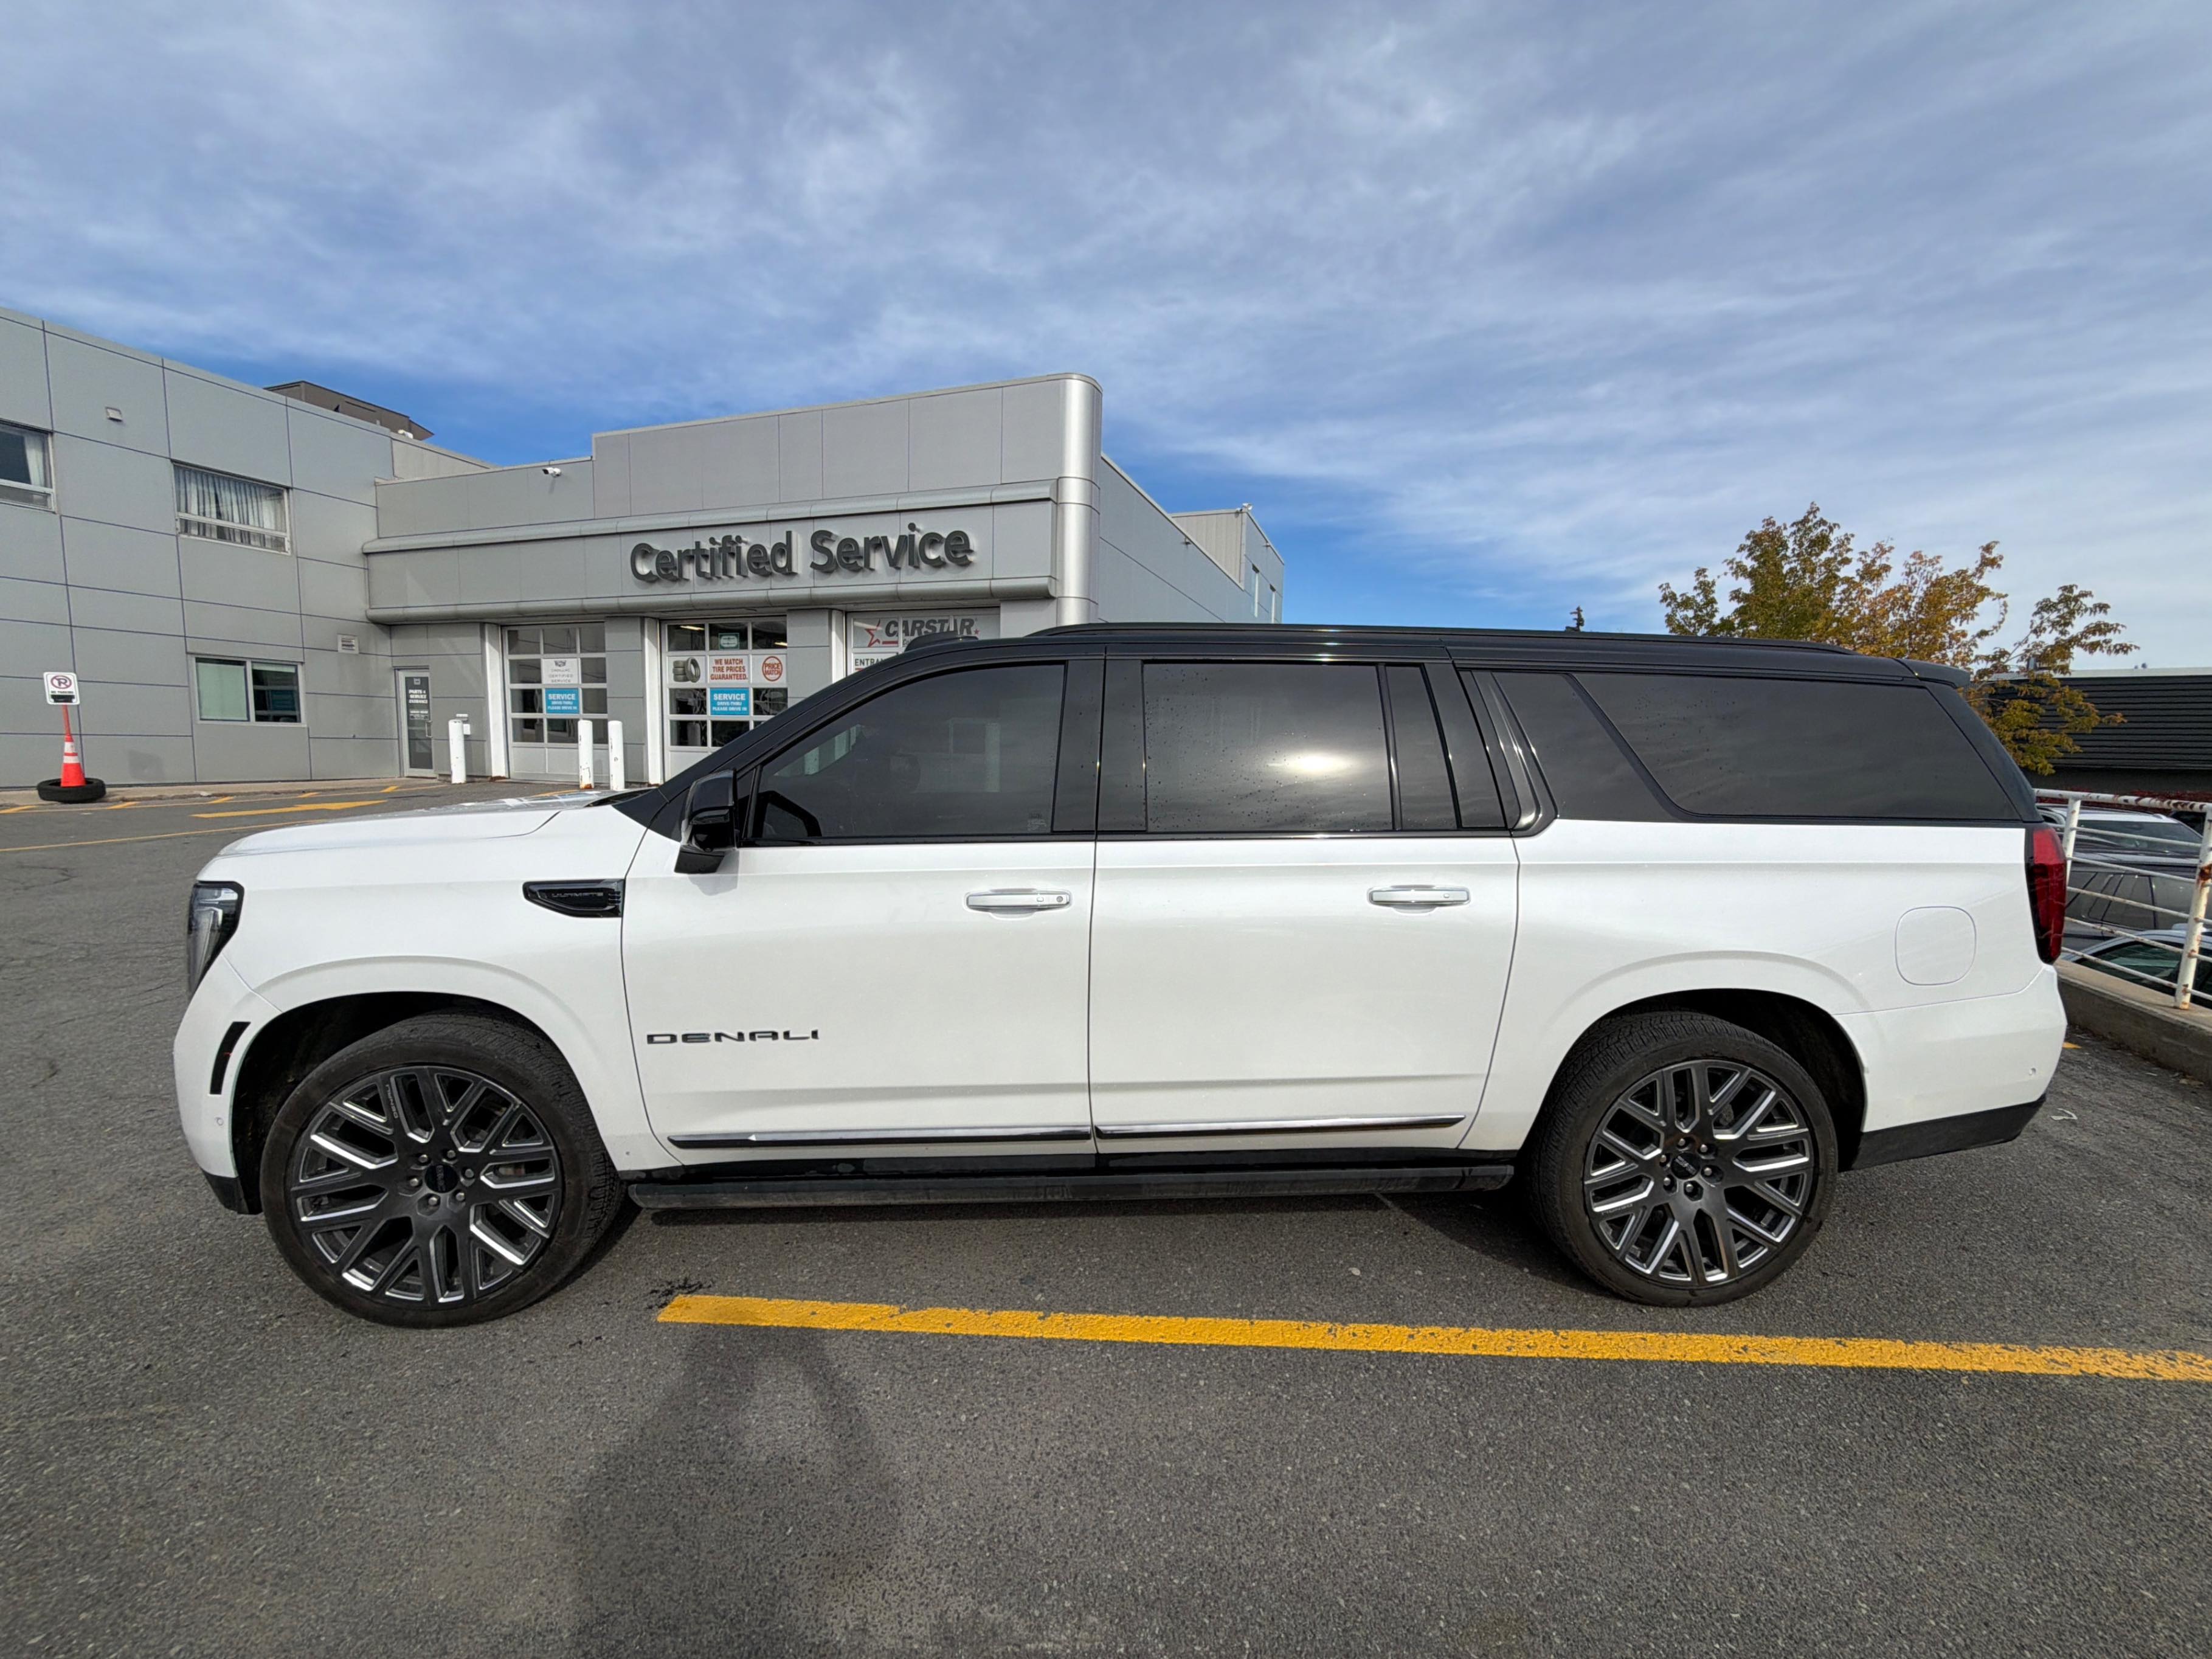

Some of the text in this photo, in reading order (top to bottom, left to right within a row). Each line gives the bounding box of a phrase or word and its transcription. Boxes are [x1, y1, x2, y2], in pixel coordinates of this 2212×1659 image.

[631, 522, 973, 582] Certified Service
[885, 618, 975, 637] CARSTAR
[854, 658, 885, 667] ENTRA
[646, 1030, 820, 1045] DENALI
